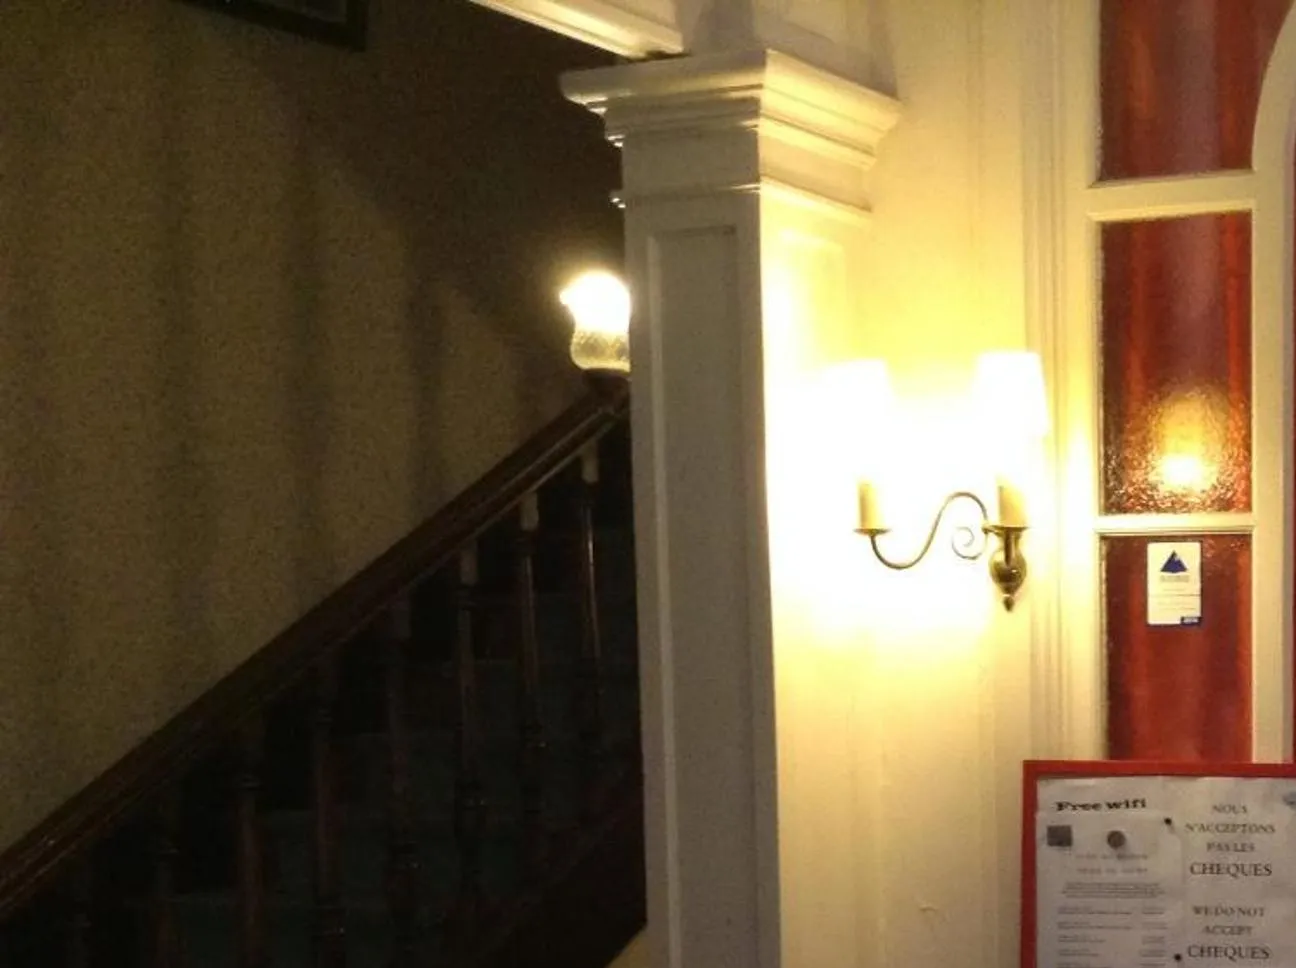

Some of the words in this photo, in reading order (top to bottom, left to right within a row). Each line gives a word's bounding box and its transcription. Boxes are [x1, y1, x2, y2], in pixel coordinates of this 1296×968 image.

[1054, 800, 1102, 812] Free
[1105, 797, 1147, 810] wifi
[1189, 862, 1273, 879] CHEQUES
[1187, 944, 1270, 962] CHEQUES
